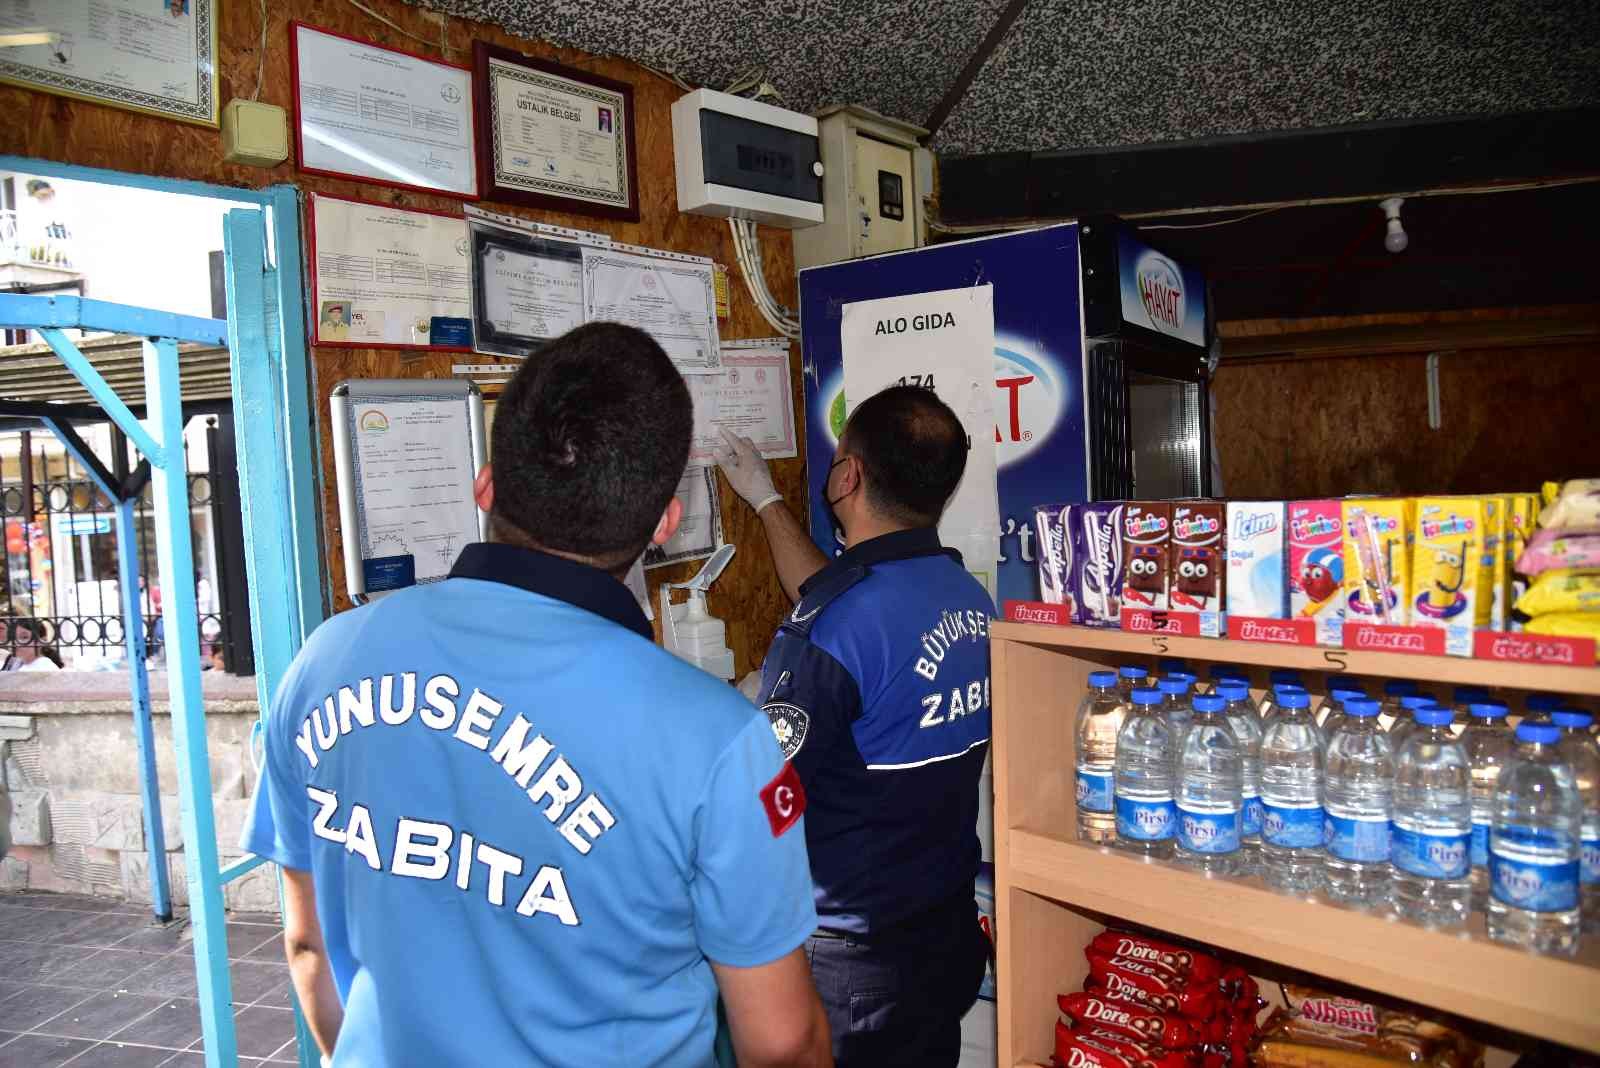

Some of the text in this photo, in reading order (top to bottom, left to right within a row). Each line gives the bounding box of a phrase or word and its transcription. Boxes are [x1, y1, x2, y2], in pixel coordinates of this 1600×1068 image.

[1143, 276, 1181, 328] HAYAT
[874, 312, 955, 335] ALO GIDA
[1015, 604, 1058, 623] ÜLKER
[1240, 621, 1299, 643] ÜLKER
[1356, 626, 1425, 650] ÜLKER
[296, 671, 618, 856] YUNUSEMRE
[1135, 811, 1169, 824] Pirsu
[1184, 819, 1218, 836] Pirsu
[305, 784, 582, 926] ZABITA
[1116, 939, 1160, 960] Dore
[1106, 972, 1148, 999] Dore
[1084, 999, 1130, 1023] Dore
